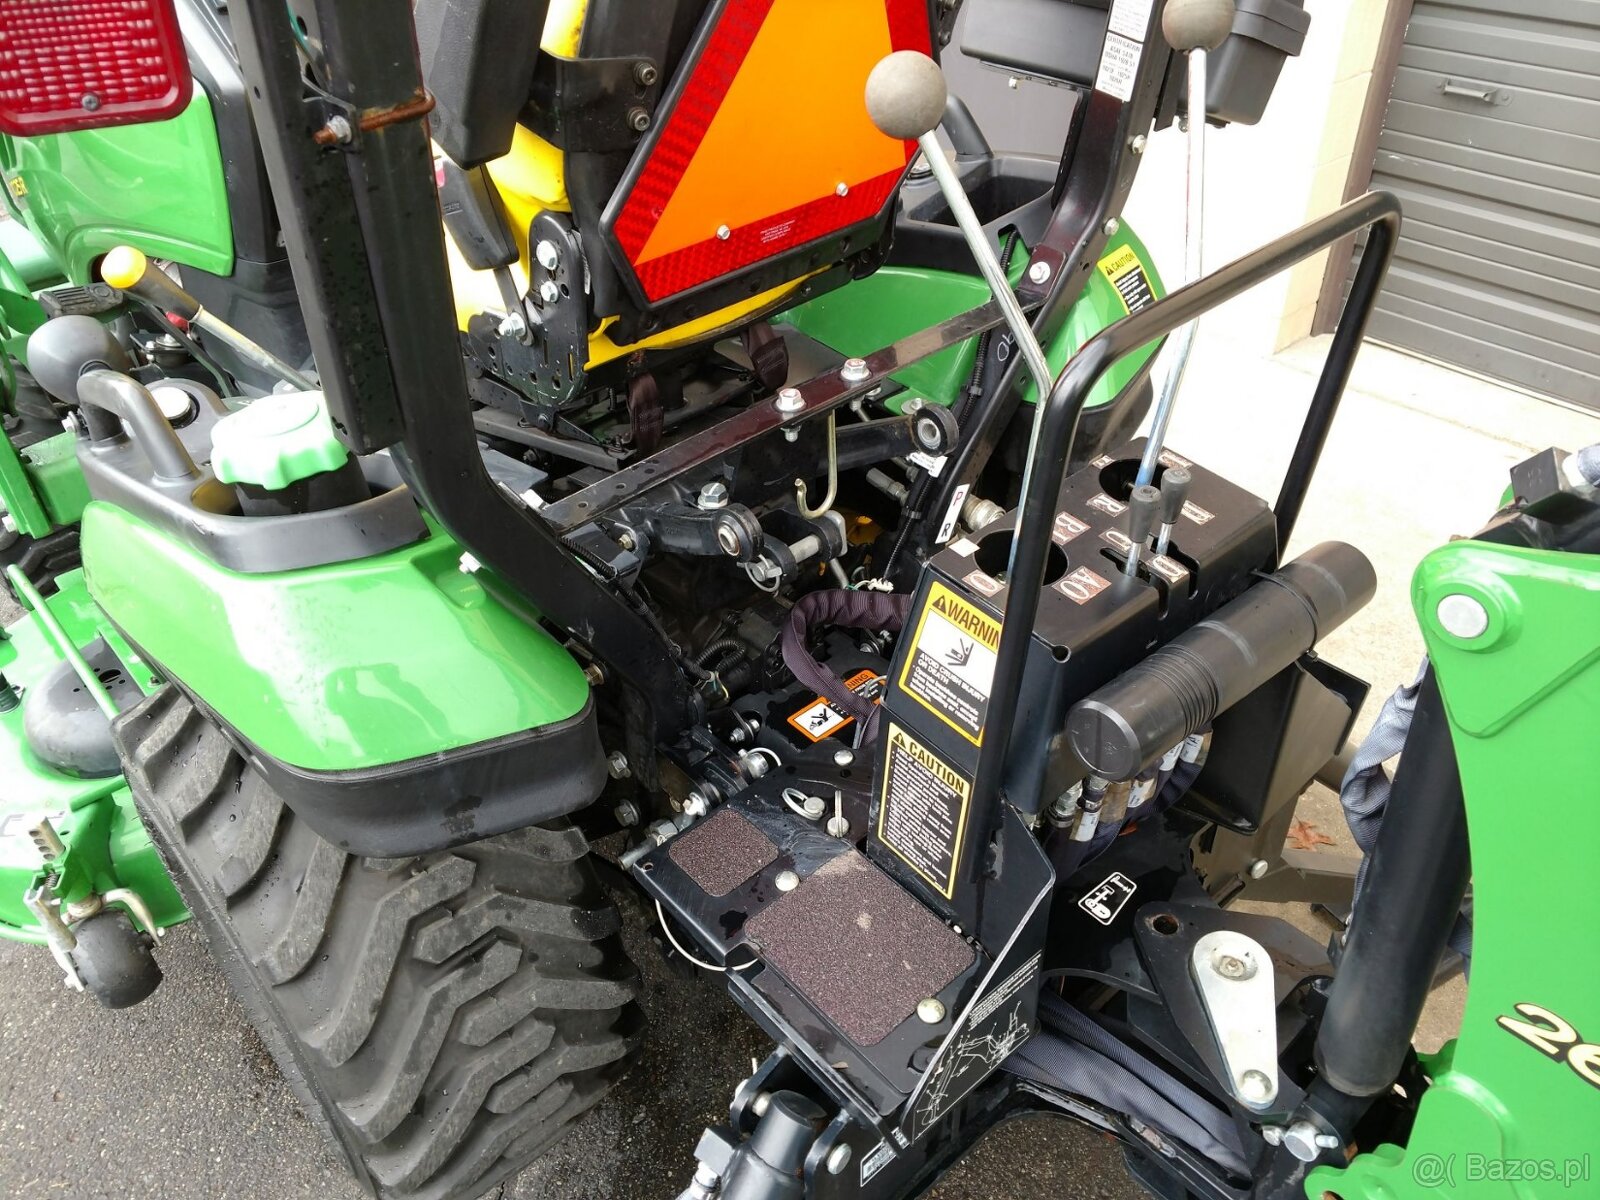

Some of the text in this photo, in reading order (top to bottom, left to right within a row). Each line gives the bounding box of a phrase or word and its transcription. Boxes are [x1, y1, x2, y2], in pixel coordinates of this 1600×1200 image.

[1111, 252, 1135, 271] CAUTION
[953, 491, 963, 506] P
[941, 523, 951, 538] R
[948, 599, 1000, 647] WARNIN
[917, 658, 948, 684] OR DEATH
[920, 651, 985, 703] AVOID CRUSH INJURY
[910, 742, 964, 794] CAUTION
